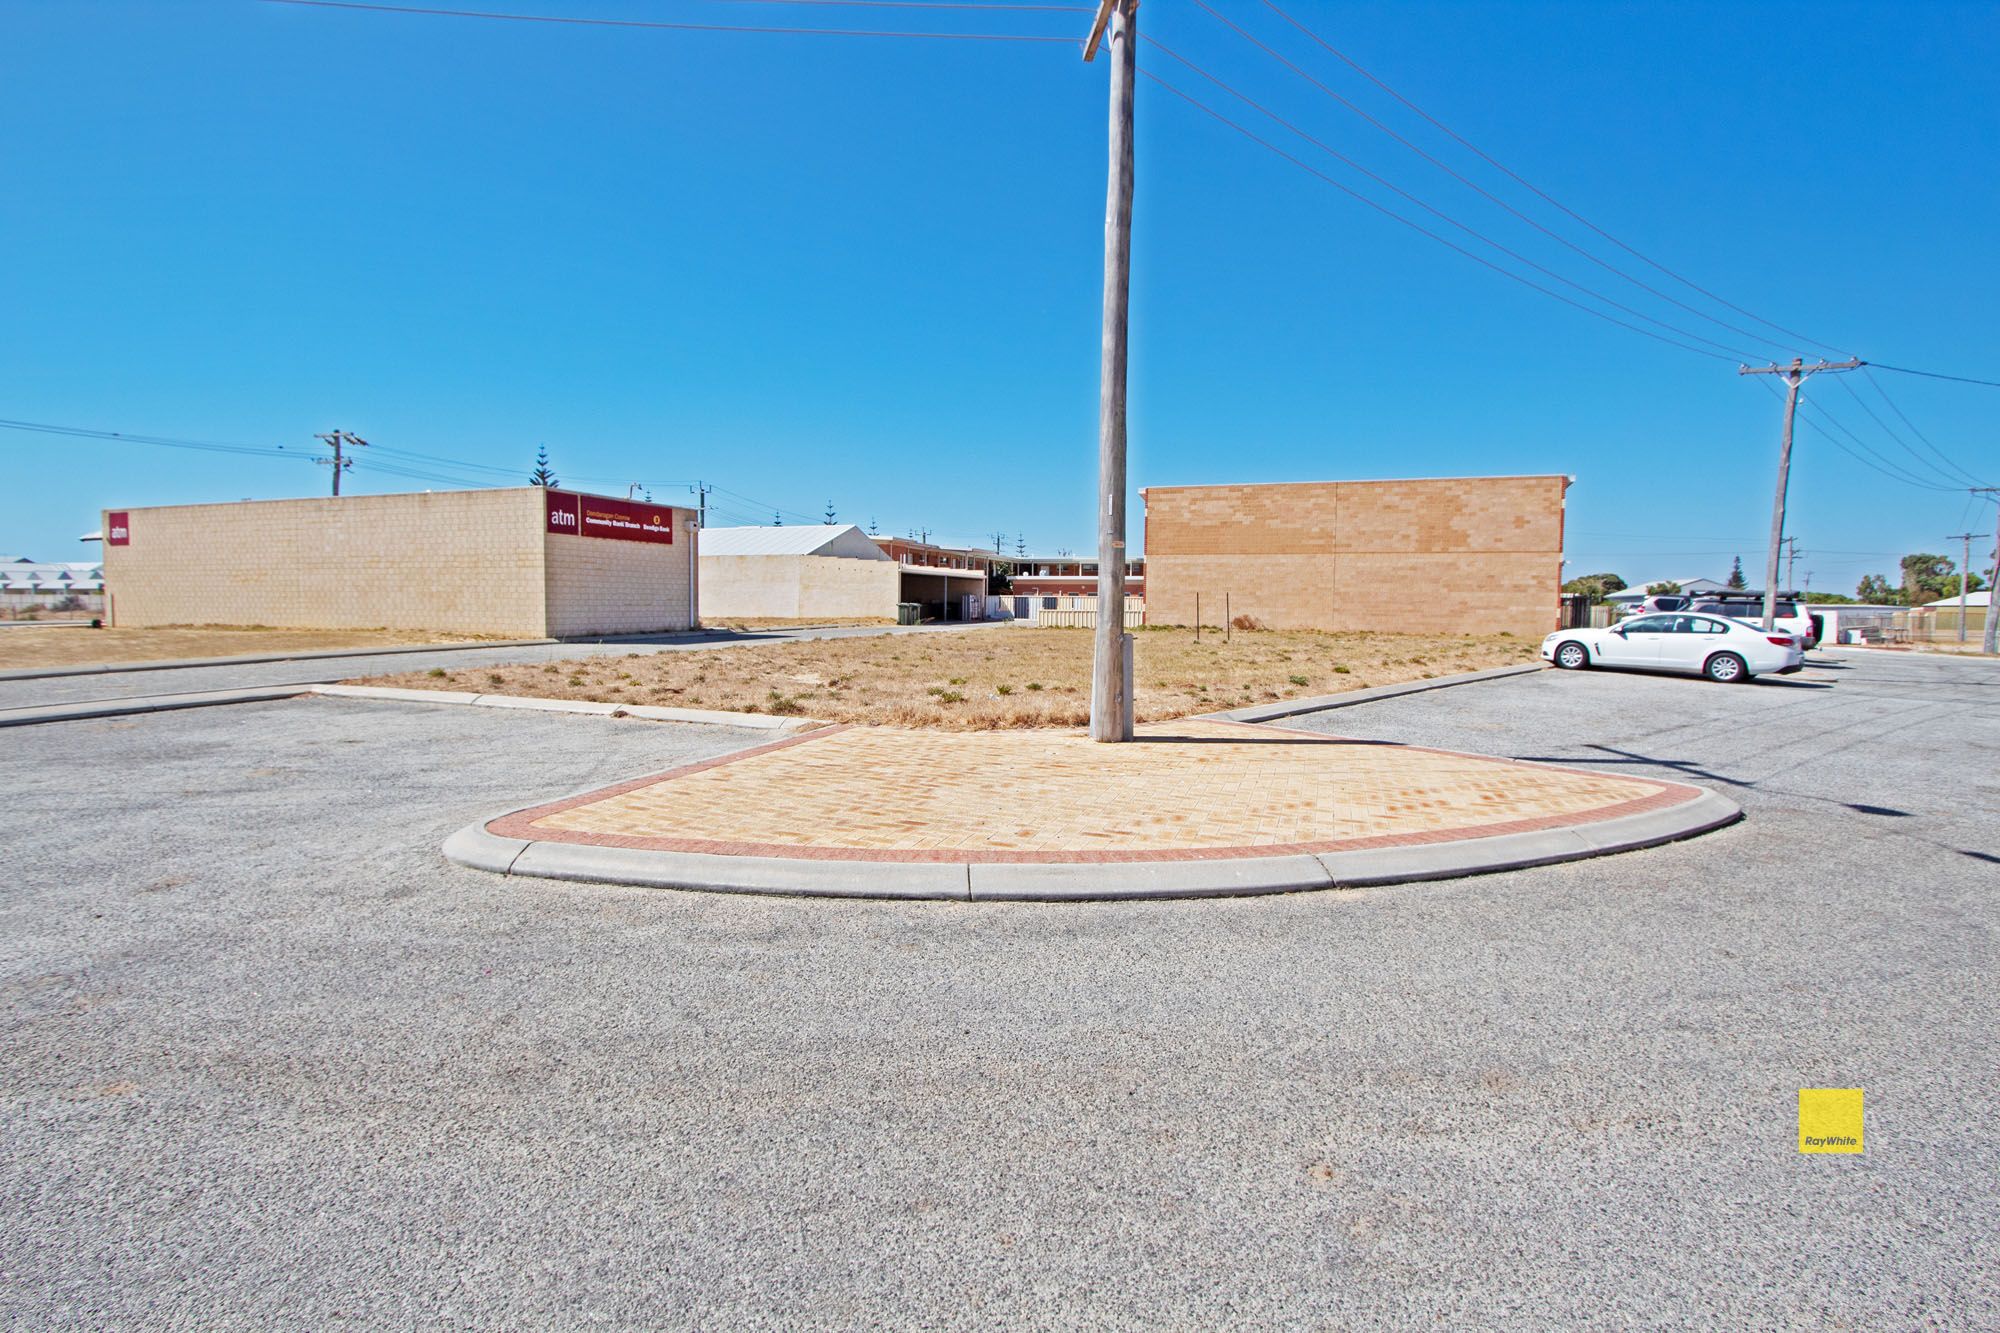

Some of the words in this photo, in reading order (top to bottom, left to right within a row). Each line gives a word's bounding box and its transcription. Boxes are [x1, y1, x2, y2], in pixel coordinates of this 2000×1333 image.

[551, 509, 575, 526] atm
[586, 517, 612, 527] Community
[625, 521, 641, 529] Branch
[643, 523, 660, 532] Bendigo
